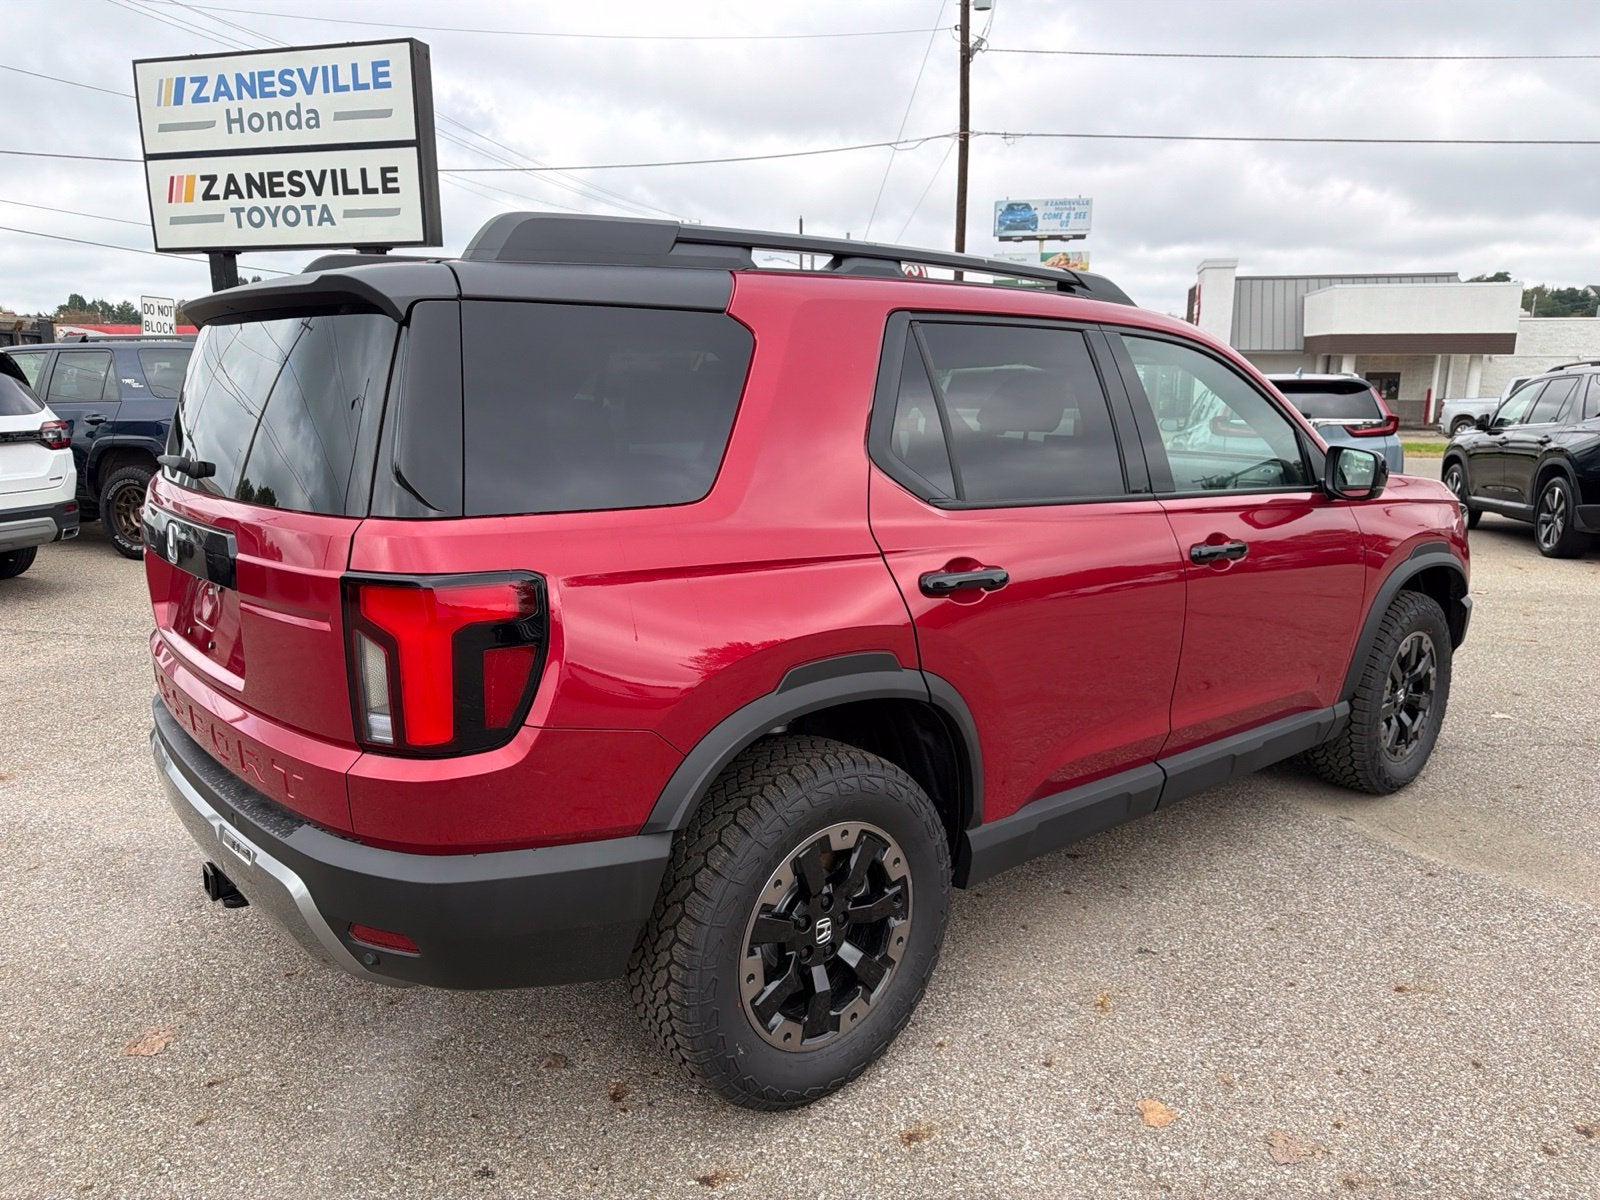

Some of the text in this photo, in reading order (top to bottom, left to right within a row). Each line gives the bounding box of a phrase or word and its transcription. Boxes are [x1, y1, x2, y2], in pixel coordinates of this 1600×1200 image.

[189, 59, 392, 104] ZANESVILLE
[225, 102, 321, 135] Honda
[200, 166, 400, 202] ZANESVILLE
[230, 204, 337, 229] TOYOTA
[1042, 211, 1064, 220] COME
[1074, 211, 1088, 220] SEE
[1059, 220, 1070, 228] US
[143, 303, 173, 318] DO NOT
[144, 320, 175, 334] BLOCK
